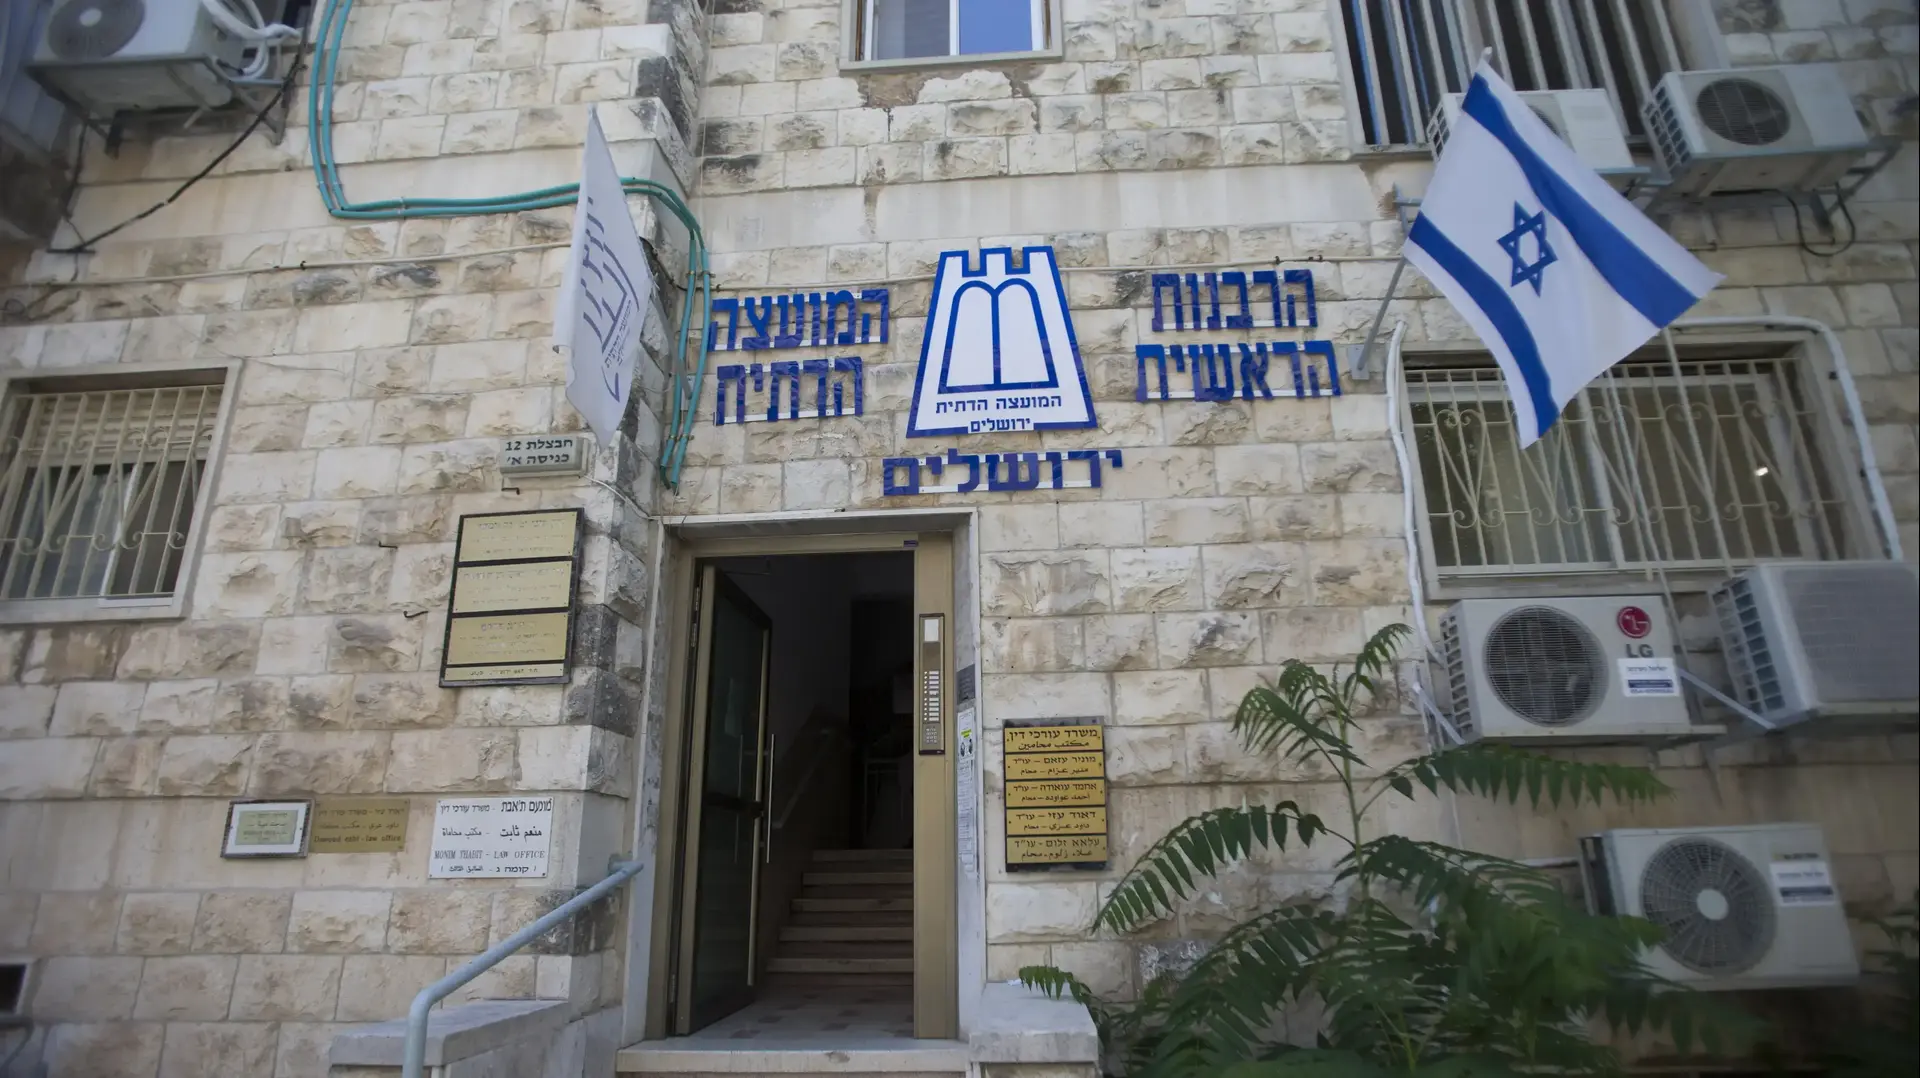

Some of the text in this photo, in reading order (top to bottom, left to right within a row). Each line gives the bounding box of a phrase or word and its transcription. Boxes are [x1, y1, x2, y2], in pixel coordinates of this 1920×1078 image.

[1151, 269, 1318, 332] הרבנות
[707, 289, 889, 352] המועצה
[1135, 340, 1341, 403] הראשית
[713, 356, 863, 426] הדתית
[936, 396, 1061, 413] המועצה הדתית
[970, 418, 1030, 432] ירושלים
[505, 439, 573, 451] חבצלת 12
[506, 453, 570, 465] כניסה א'
[882, 448, 1123, 496] ירושלים
[1625, 643, 1654, 658] LG
[1009, 729, 1097, 741] משרד עורכי דין
[1054, 740, 1089, 748] مكتب
[1072, 783, 1097, 791] אחמד
[472, 804, 490, 812] משרד
[1048, 812, 1065, 820] עזי
[1069, 811, 1096, 819] דאוד
[1046, 839, 1066, 847] זלום
[1072, 837, 1100, 847] עלאא
